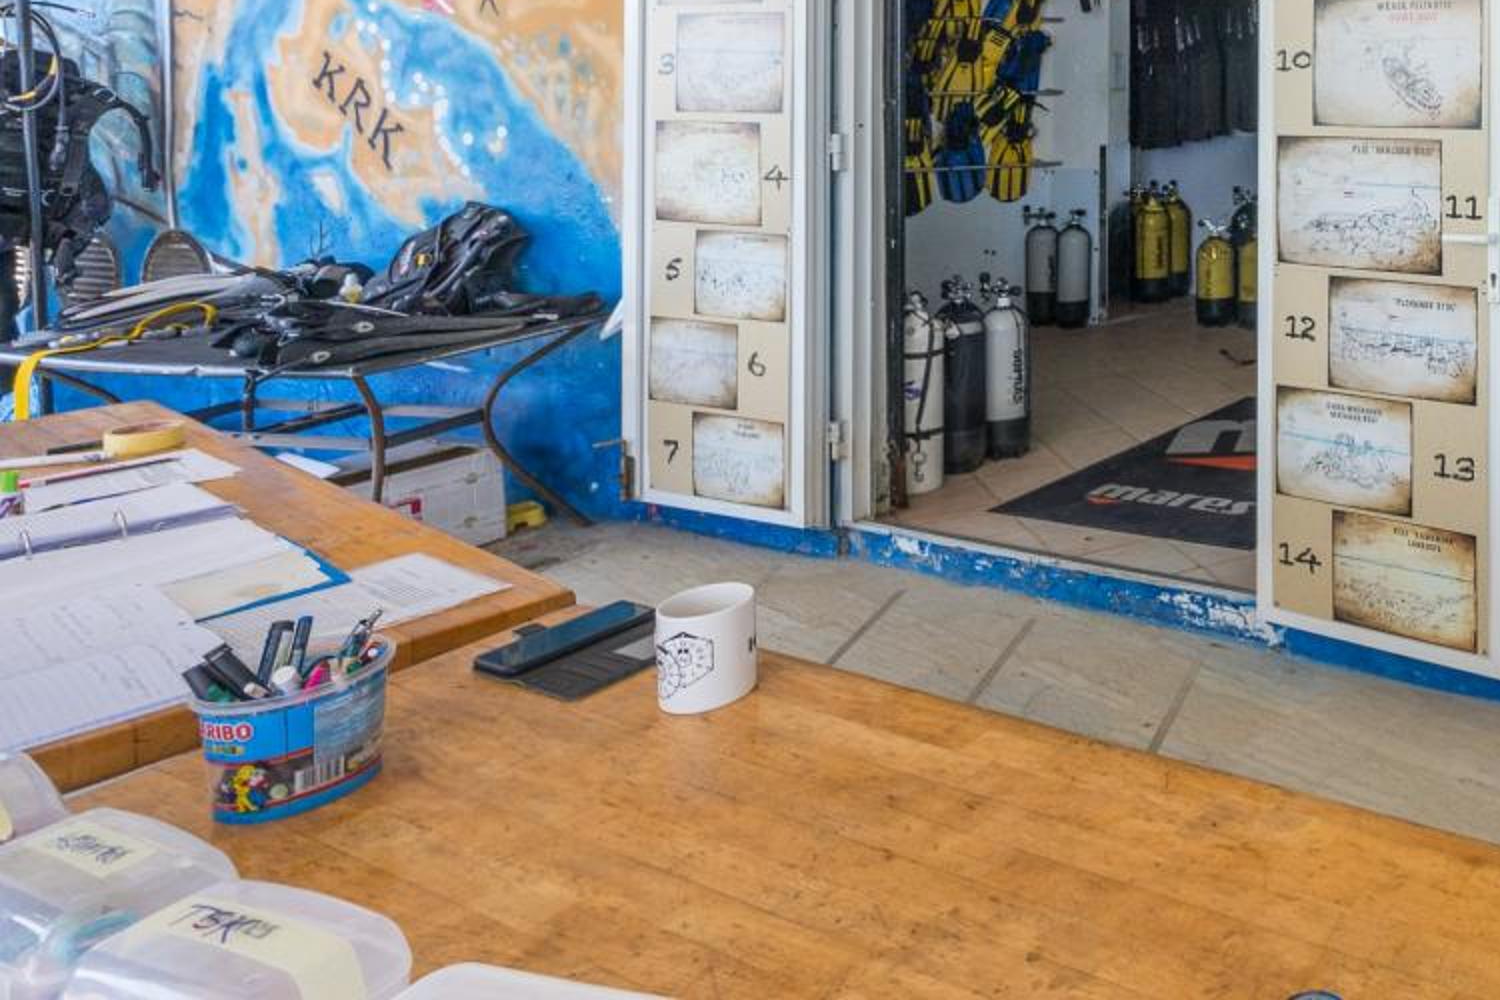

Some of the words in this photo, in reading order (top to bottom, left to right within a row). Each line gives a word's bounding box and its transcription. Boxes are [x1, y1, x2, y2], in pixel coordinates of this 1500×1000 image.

[657, 53, 675, 75] 3
[1276, 49, 1311, 72] 10
[312, 50, 404, 171] KRK
[764, 165, 789, 190] 4
[1445, 195, 1482, 220] 11
[664, 258, 682, 281] 5
[1285, 315, 1316, 341] 12
[748, 352, 766, 377] 6
[663, 440, 680, 465] 7
[1432, 453, 1476, 481] 13
[1279, 543, 1322, 573] 14
